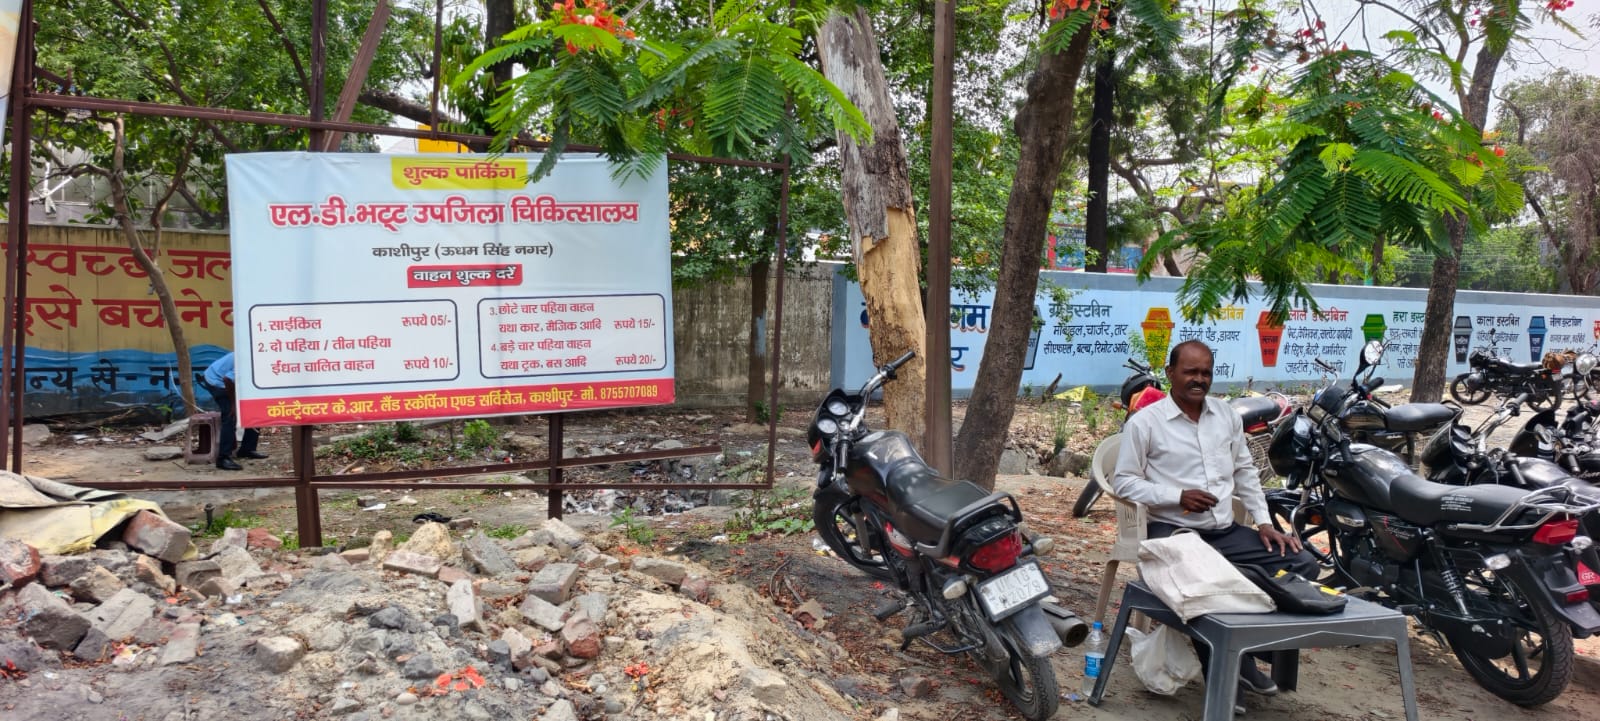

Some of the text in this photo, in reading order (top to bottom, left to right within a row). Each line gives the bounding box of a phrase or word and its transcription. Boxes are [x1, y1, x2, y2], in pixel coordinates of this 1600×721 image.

[403, 162, 516, 182] शुल्क पार्किंग
[412, 195, 505, 226] उपजिला
[511, 195, 640, 225] चिकित्सालय
[372, 242, 553, 261] काशीपुर (ऊधम सिंह नगर)
[413, 266, 516, 284] वाहन शुल्क दरें
[92, 288, 213, 329] बचने
[498, 302, 518, 315] छोटे
[521, 303, 538, 314] चार
[540, 301, 567, 314] पहिया
[569, 302, 595, 313] वाहन
[430, 314, 452, 327] 05/-
[499, 322, 517, 333] यथा
[546, 319, 577, 332] मैजिक
[580, 318, 602, 331] आदि
[638, 319, 656, 329] 15/-
[1393, 311, 1409, 323] हरा
[1476, 316, 1495, 326] काला
[270, 339, 282, 353] दो
[286, 338, 320, 352] पहिया
[324, 339, 329, 351] /
[332, 336, 355, 350] तीन
[358, 335, 392, 350] पहिया
[518, 340, 534, 351] चार
[537, 339, 565, 352] पहिया
[567, 339, 592, 350] वाहन
[304, 358, 340, 373] चालित
[344, 359, 375, 372] वाहन
[433, 357, 453, 369] 10/-
[501, 360, 519, 371] यथा
[546, 359, 562, 370] बस
[565, 355, 587, 368] आदि
[639, 355, 657, 365] 20/-
[90, 358, 119, 391] से
[380, 395, 401, 411] लैंड
[451, 395, 476, 411] एण्ड
[580, 385, 598, 401] मो.
